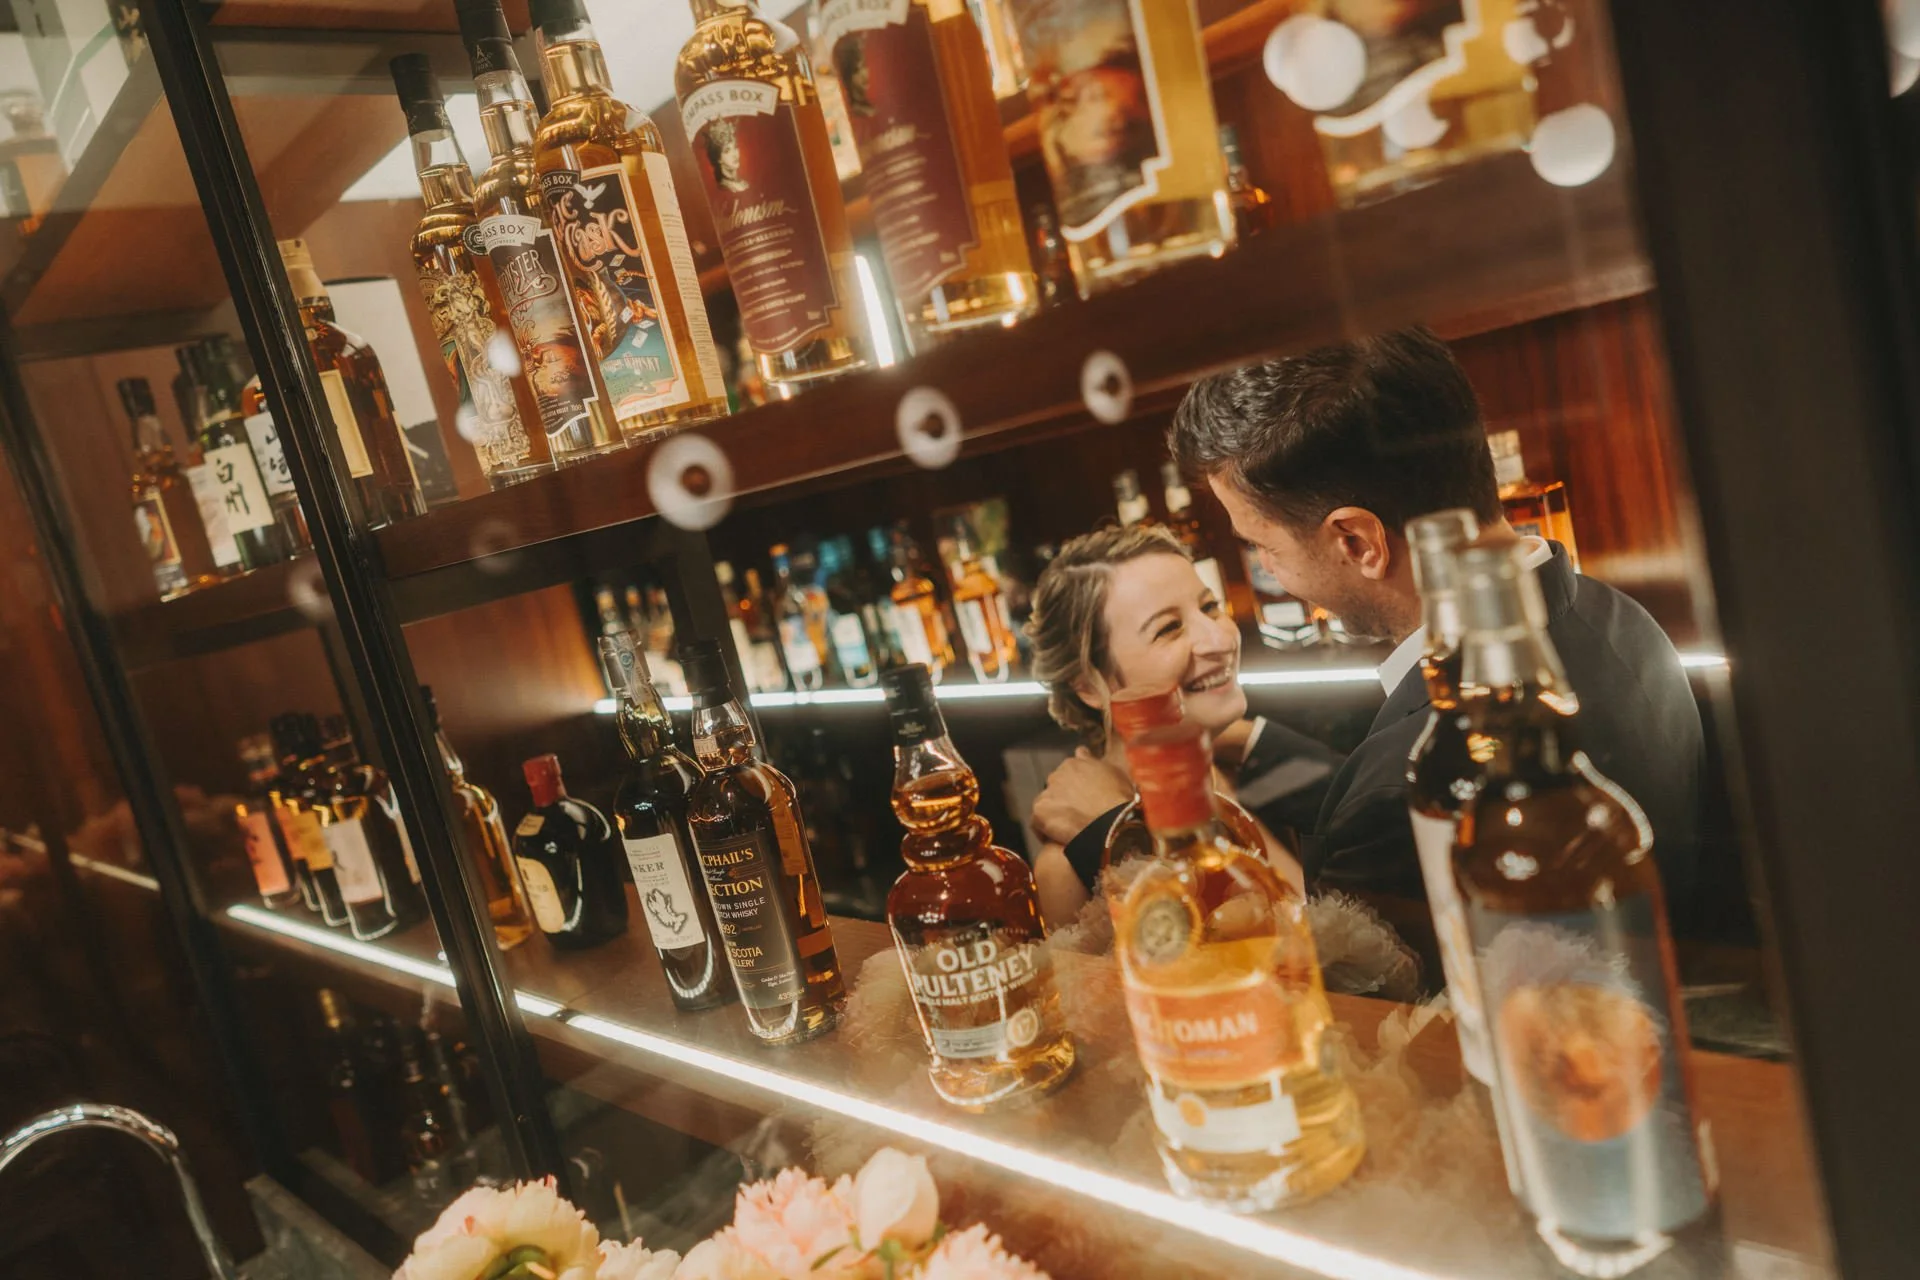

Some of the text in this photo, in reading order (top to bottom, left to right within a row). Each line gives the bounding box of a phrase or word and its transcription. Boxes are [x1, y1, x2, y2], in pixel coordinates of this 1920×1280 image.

[729, 89, 764, 102] BOX
[553, 175, 573, 185] BOX
[500, 224, 526, 236] BOX
[733, 896, 766, 910] SINGLE
[731, 908, 758, 919] WHISKY
[731, 946, 763, 958] SCOTIA
[936, 940, 998, 973] OLD
